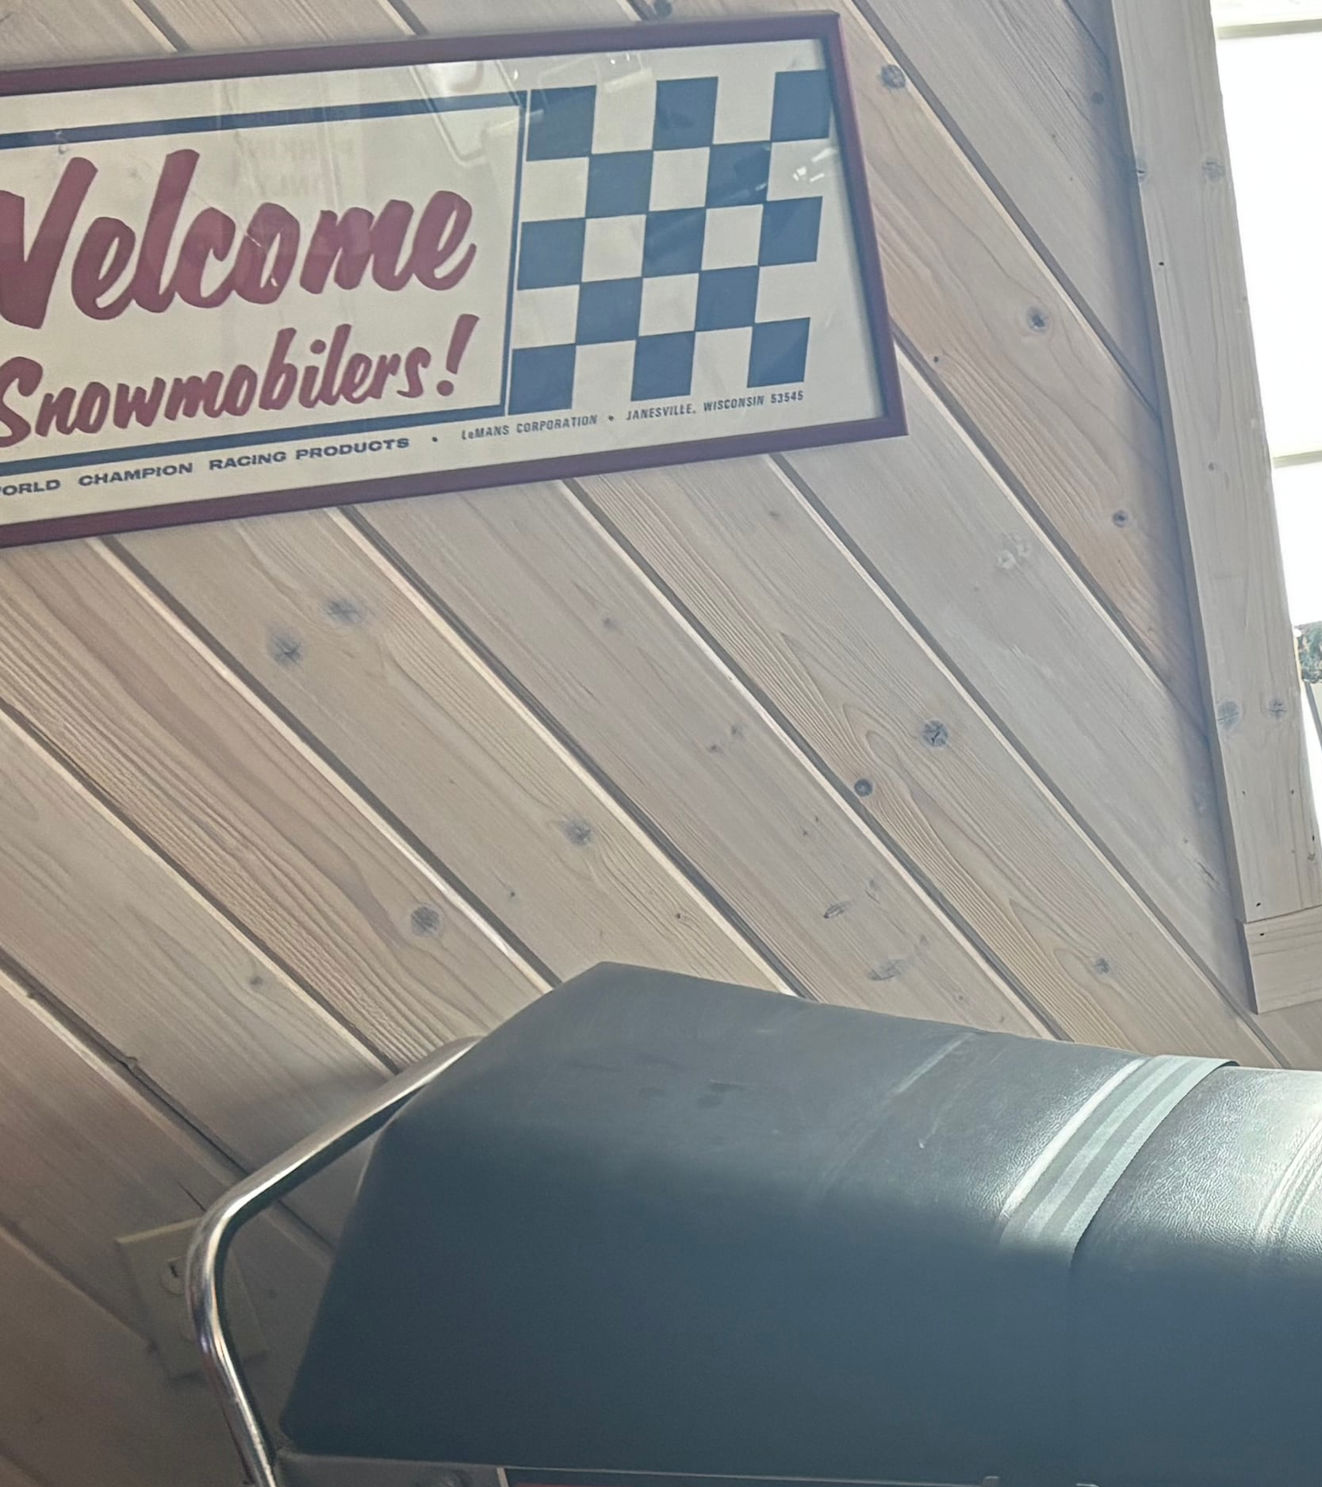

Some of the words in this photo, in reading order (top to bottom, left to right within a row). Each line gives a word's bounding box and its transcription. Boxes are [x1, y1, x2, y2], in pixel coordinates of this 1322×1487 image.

[0, 313, 480, 448] Snowmobilers!
[516, 414, 598, 434] CORPORATION
[703, 394, 765, 412] WISCONSIN
[0, 478, 61, 497] ORLD
[78, 462, 194, 487] CHAMPION
[209, 451, 287, 472] RACING
[295, 437, 410, 460] PRODUCTS
